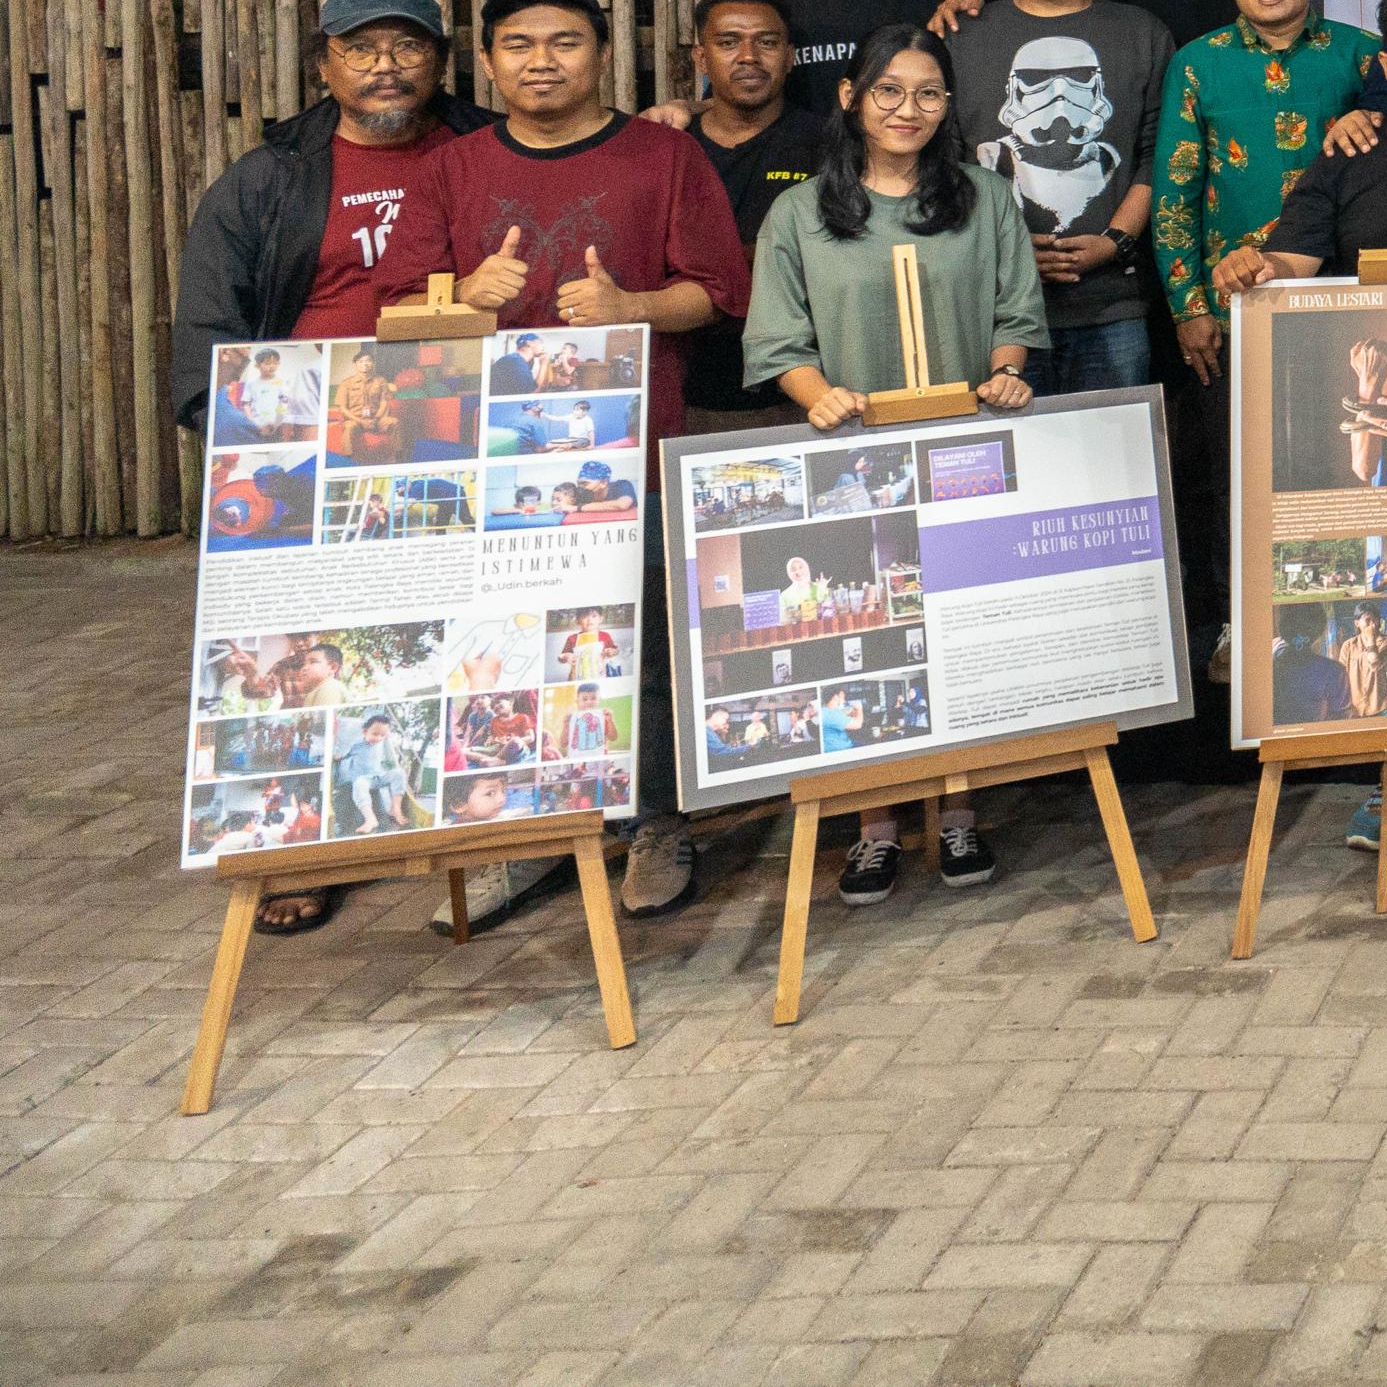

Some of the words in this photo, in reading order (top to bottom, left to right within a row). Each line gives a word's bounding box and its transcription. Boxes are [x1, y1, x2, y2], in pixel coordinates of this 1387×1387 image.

[766, 171, 791, 181] KFB
[342, 188, 406, 208] PEMECAHA
[1288, 294, 1333, 309] BUDAYA
[1336, 292, 1383, 307] LESTARI
[1031, 516, 1066, 537] RIUH
[1071, 505, 1149, 531] KESUNYIAN
[482, 531, 579, 555] MENUNTUN
[591, 527, 638, 546] YANG
[1083, 529, 1116, 549] KOPI
[1121, 524, 1151, 544] TULI
[481, 552, 588, 576] ISTIMEWA
